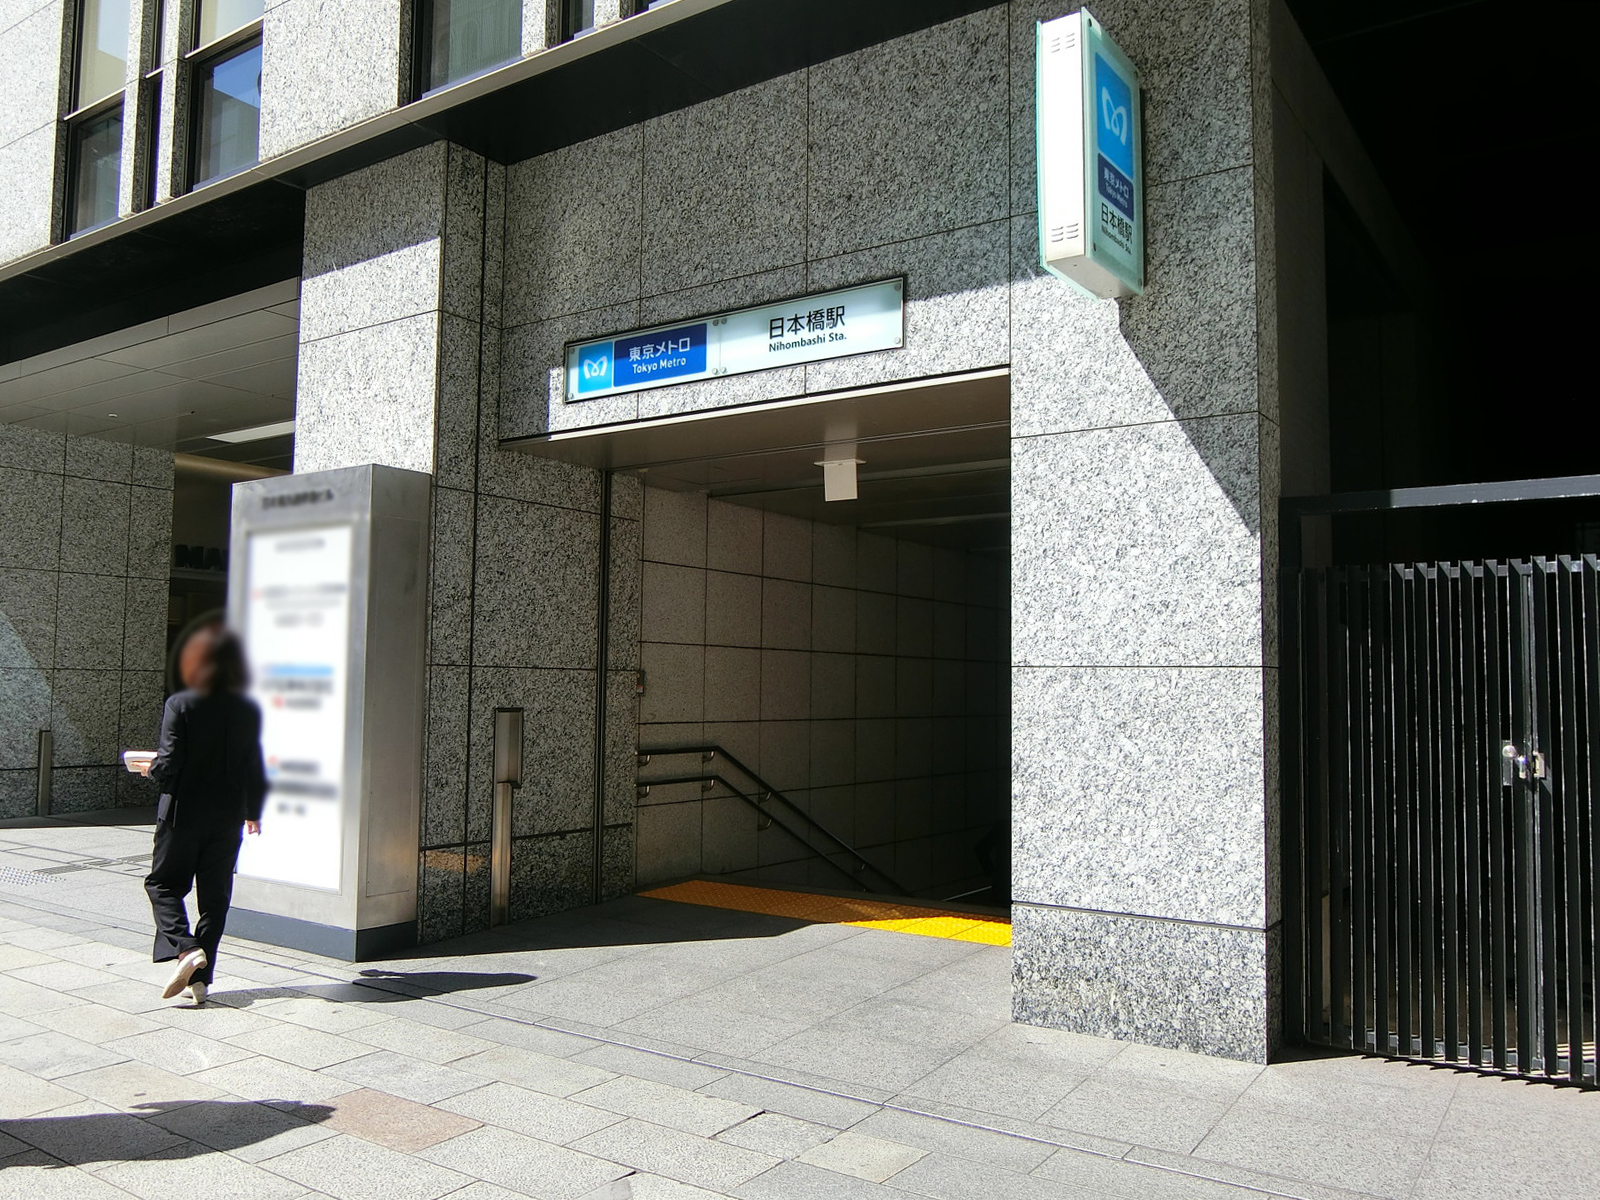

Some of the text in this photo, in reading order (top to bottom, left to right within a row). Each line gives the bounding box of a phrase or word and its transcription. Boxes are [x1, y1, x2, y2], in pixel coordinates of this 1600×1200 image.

[1101, 202, 1133, 245] 日本橋駅
[769, 305, 845, 340] 日本橋駅
[628, 337, 690, 362] 東京メトロ
[768, 331, 847, 353] Nihombashi Sta.
[632, 357, 687, 374] Tokyo Metro
